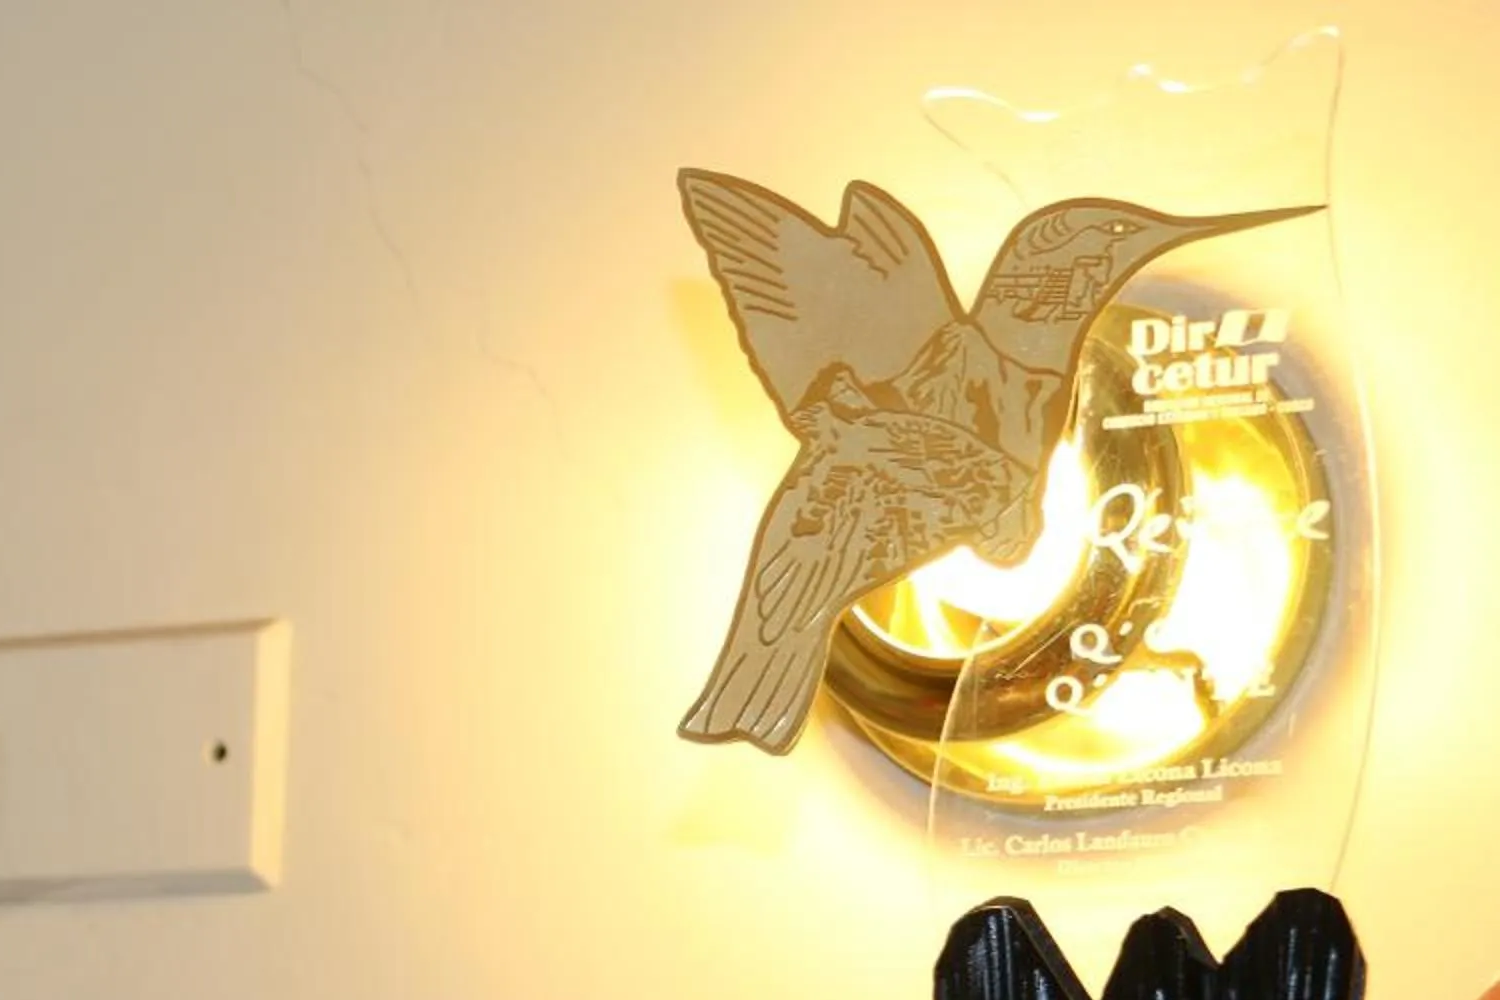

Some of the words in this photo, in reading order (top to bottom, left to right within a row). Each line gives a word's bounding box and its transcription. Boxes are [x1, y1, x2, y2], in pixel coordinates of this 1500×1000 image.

[1132, 315, 1215, 355] Dir
[1132, 353, 1280, 396] cetur
[1142, 785, 1224, 808] Regional
[1005, 833, 1073, 858] Carlos
